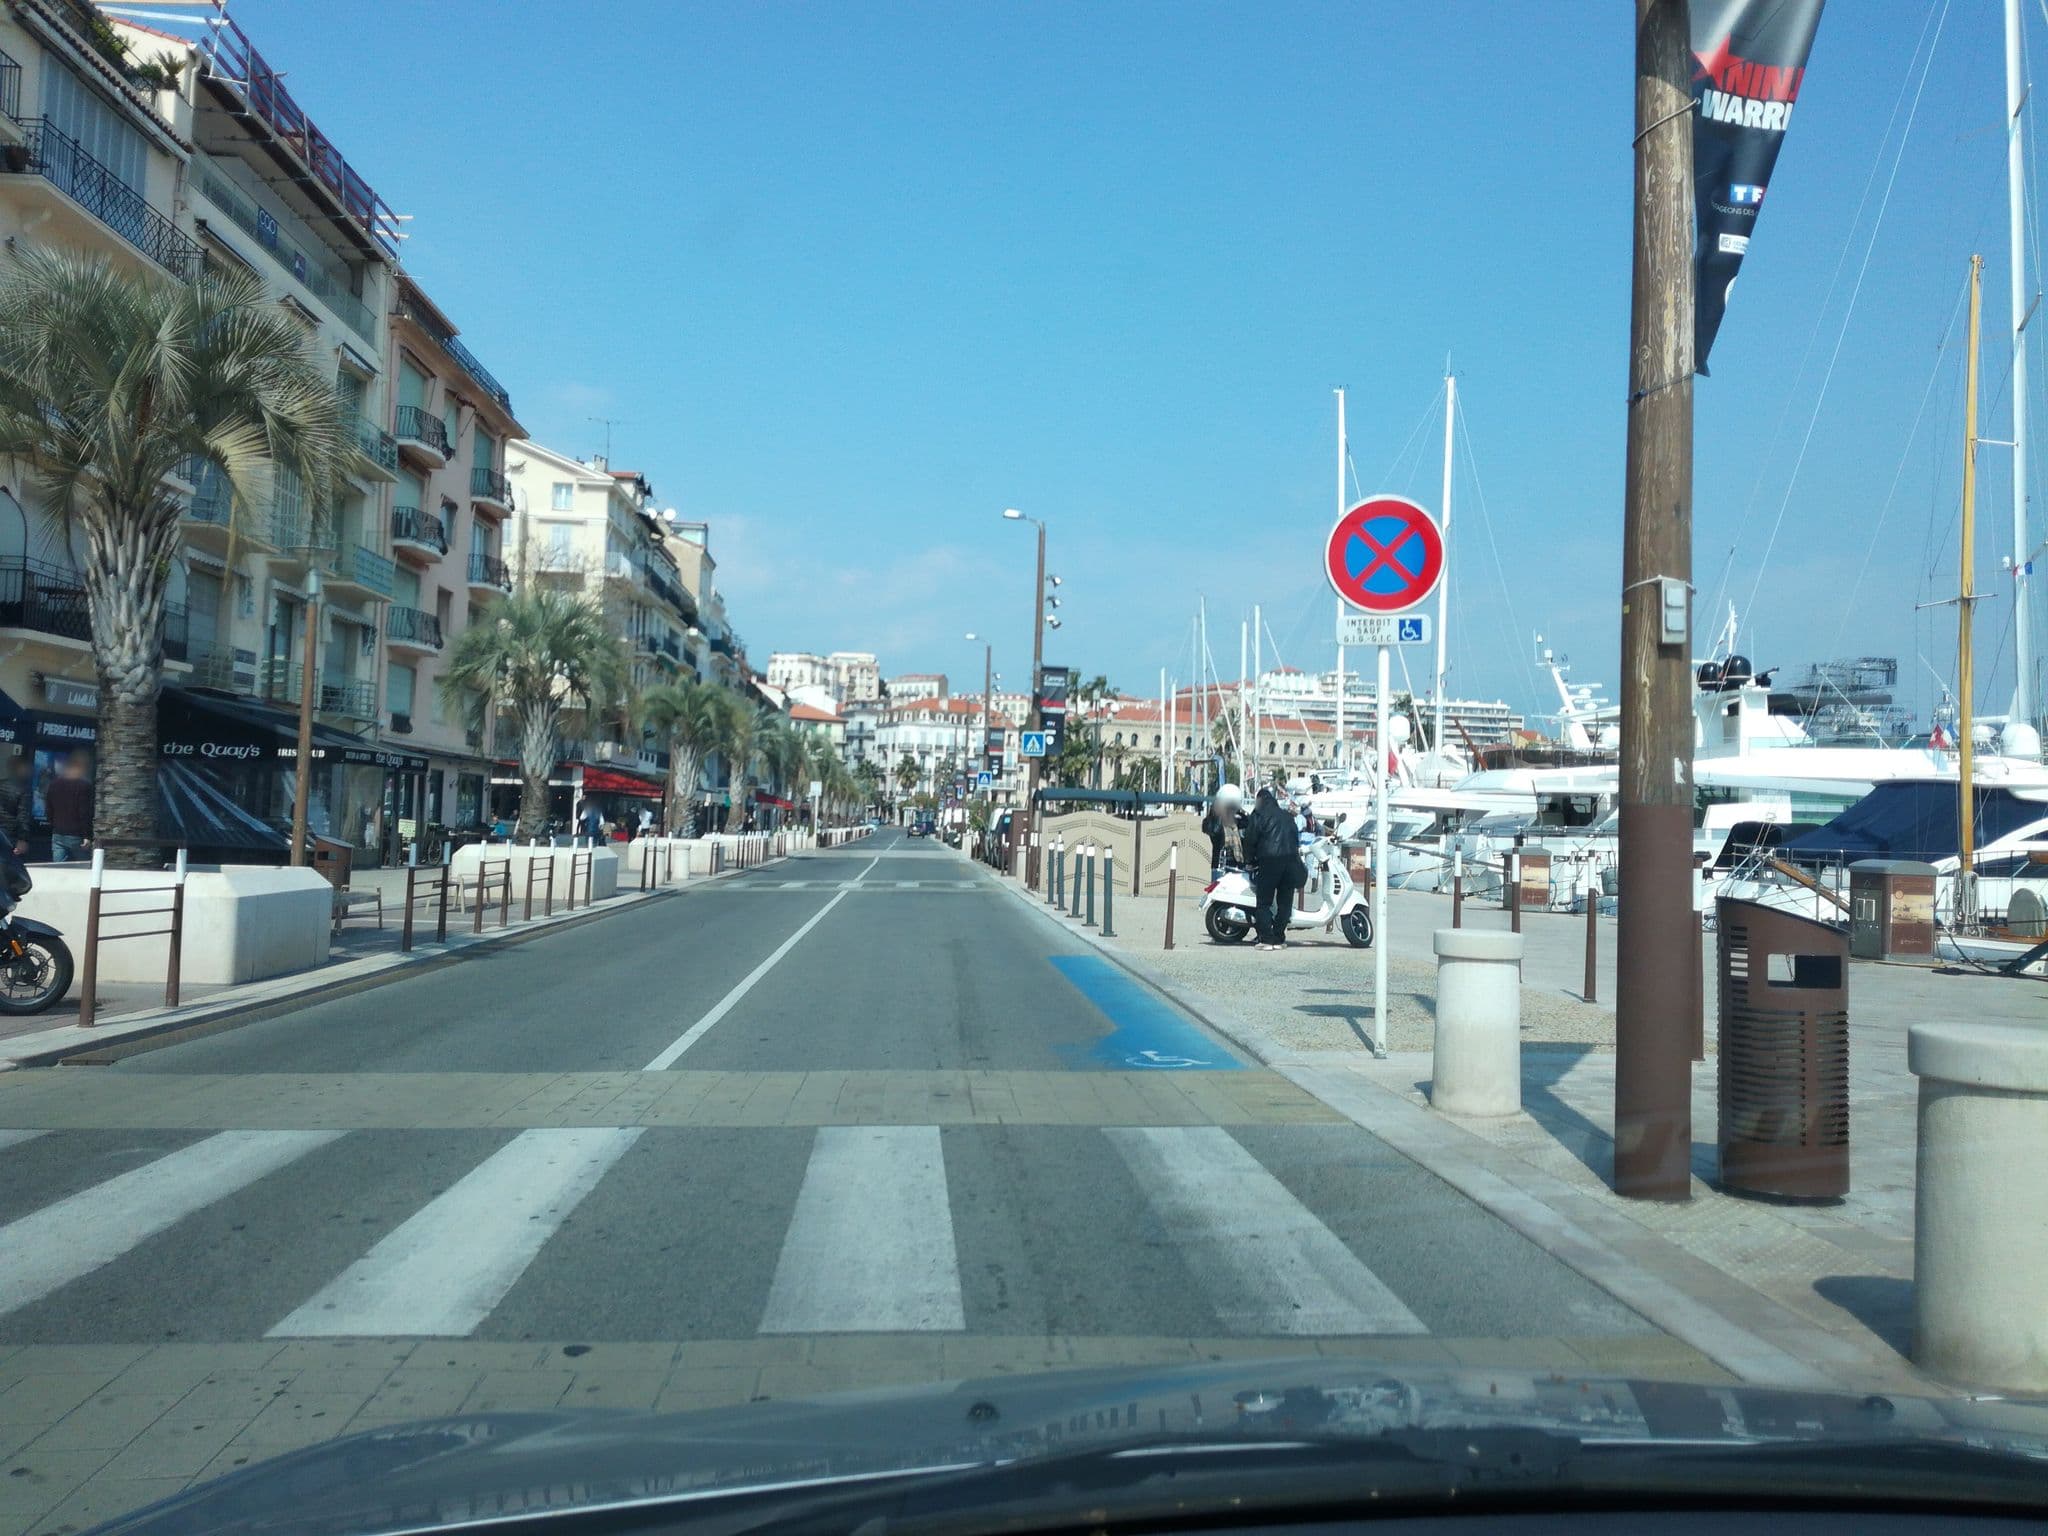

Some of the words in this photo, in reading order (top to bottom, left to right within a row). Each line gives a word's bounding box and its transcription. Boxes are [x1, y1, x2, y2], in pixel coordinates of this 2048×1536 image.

[1346, 619, 1391, 627] INTERDIT
[1357, 627, 1382, 635] SAUF
[163, 742, 194, 755] the
[200, 742, 261, 759] Quay's
[277, 748, 298, 758] IRIS
